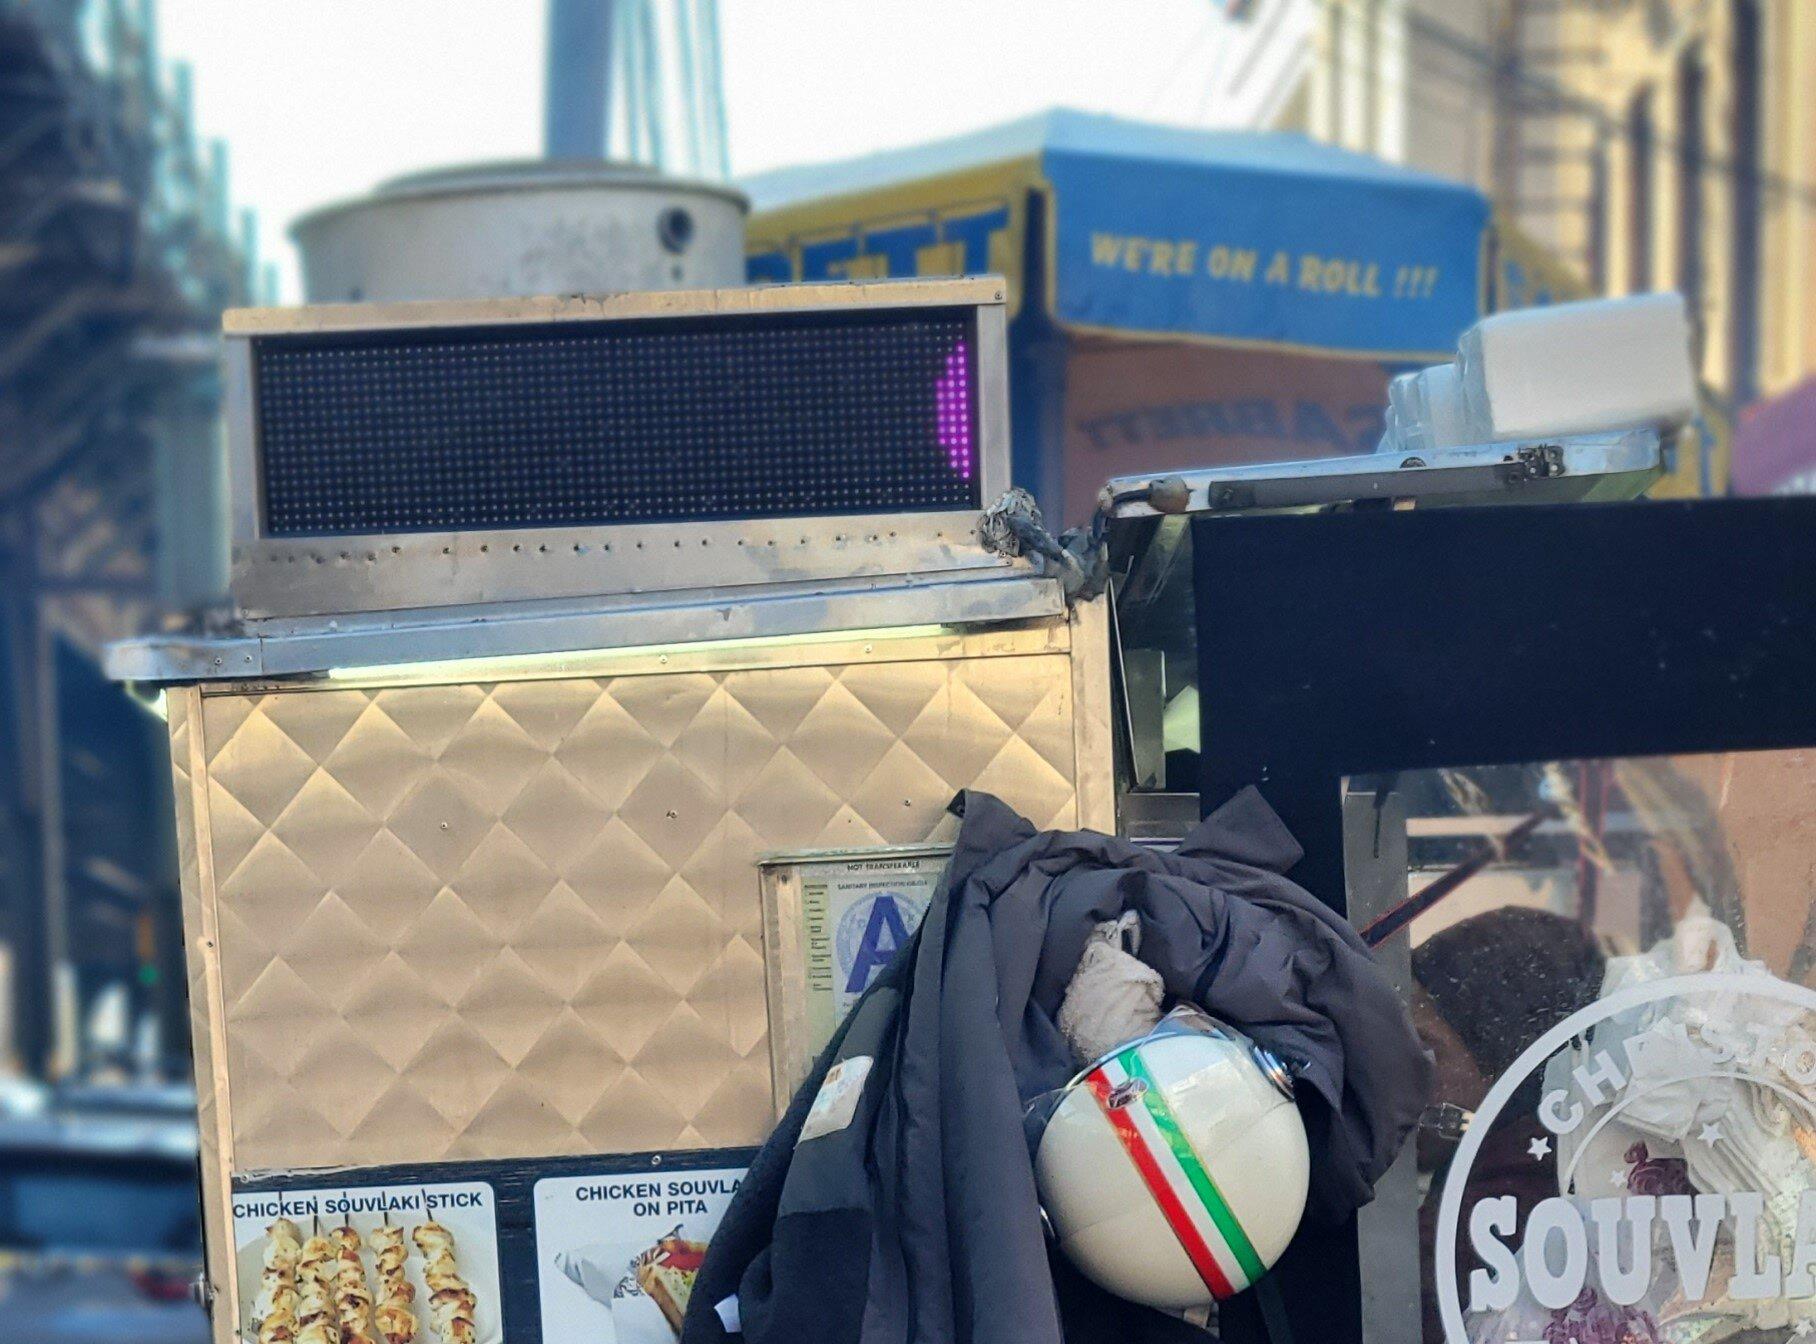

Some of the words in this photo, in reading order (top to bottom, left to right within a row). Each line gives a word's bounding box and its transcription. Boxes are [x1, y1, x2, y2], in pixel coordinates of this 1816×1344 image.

[1092, 233, 1197, 277] WE'RE
[1208, 245, 1257, 282] ON
[1266, 252, 1289, 285] A
[1299, 255, 1382, 296] ROLL
[1395, 266, 1438, 298] !!!
[845, 896, 912, 993] A
[576, 1183, 661, 1201] CHICKEN
[668, 1179, 741, 1197] SOUVLA
[233, 1200, 318, 1218] CHICKEN
[325, 1195, 420, 1214] SOUVLAKI
[426, 1191, 482, 1208] STICK
[633, 1202, 660, 1216] ON
[667, 1200, 708, 1215] PITA
